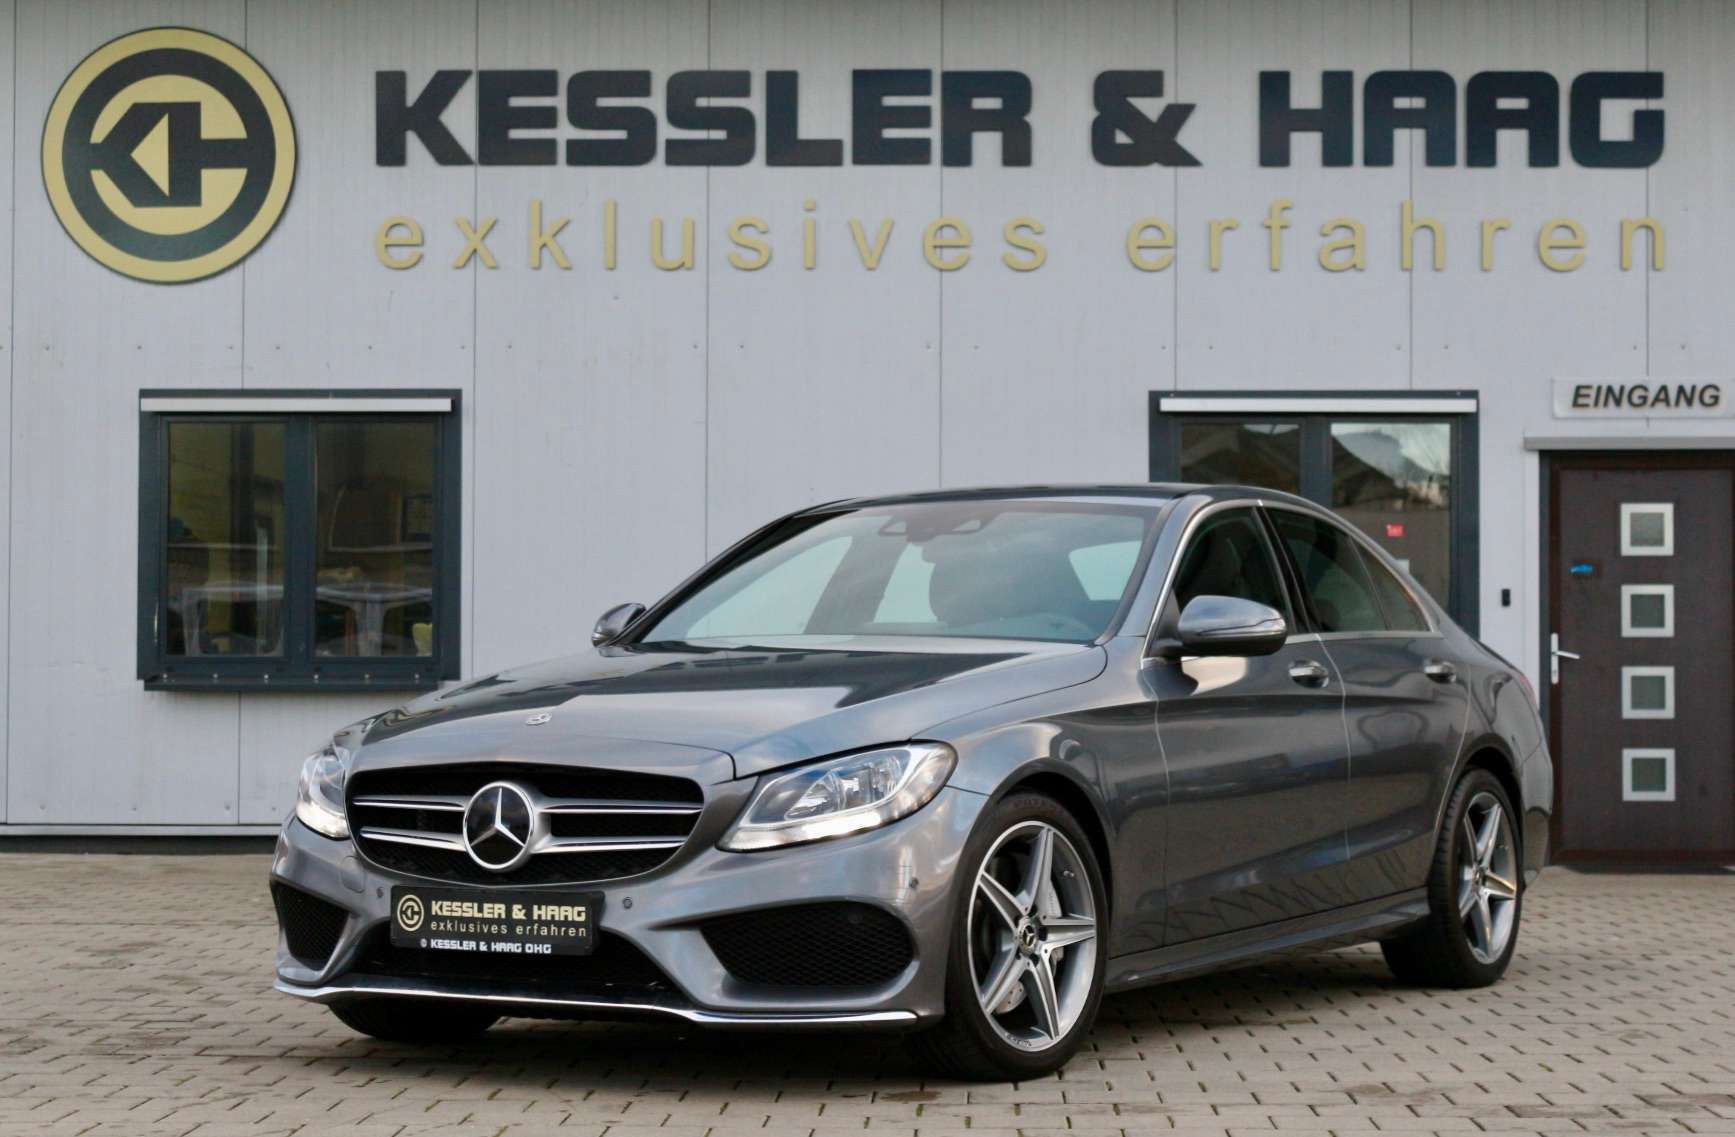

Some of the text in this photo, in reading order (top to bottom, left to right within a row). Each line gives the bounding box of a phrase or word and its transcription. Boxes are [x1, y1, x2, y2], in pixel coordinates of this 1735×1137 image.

[376, 69, 1665, 169] KESSLER & HAAG
[375, 199, 1667, 272] exklusives erfahren
[1571, 384, 1721, 409] EINGANG
[431, 900, 587, 922] KESSLER & HAAG
[430, 921, 587, 937] exklusives erfahren
[430, 938, 477, 951] KESSLER
[479, 941, 489, 951] &
[491, 942, 522, 953] HAAG
[525, 943, 552, 954] OHG
